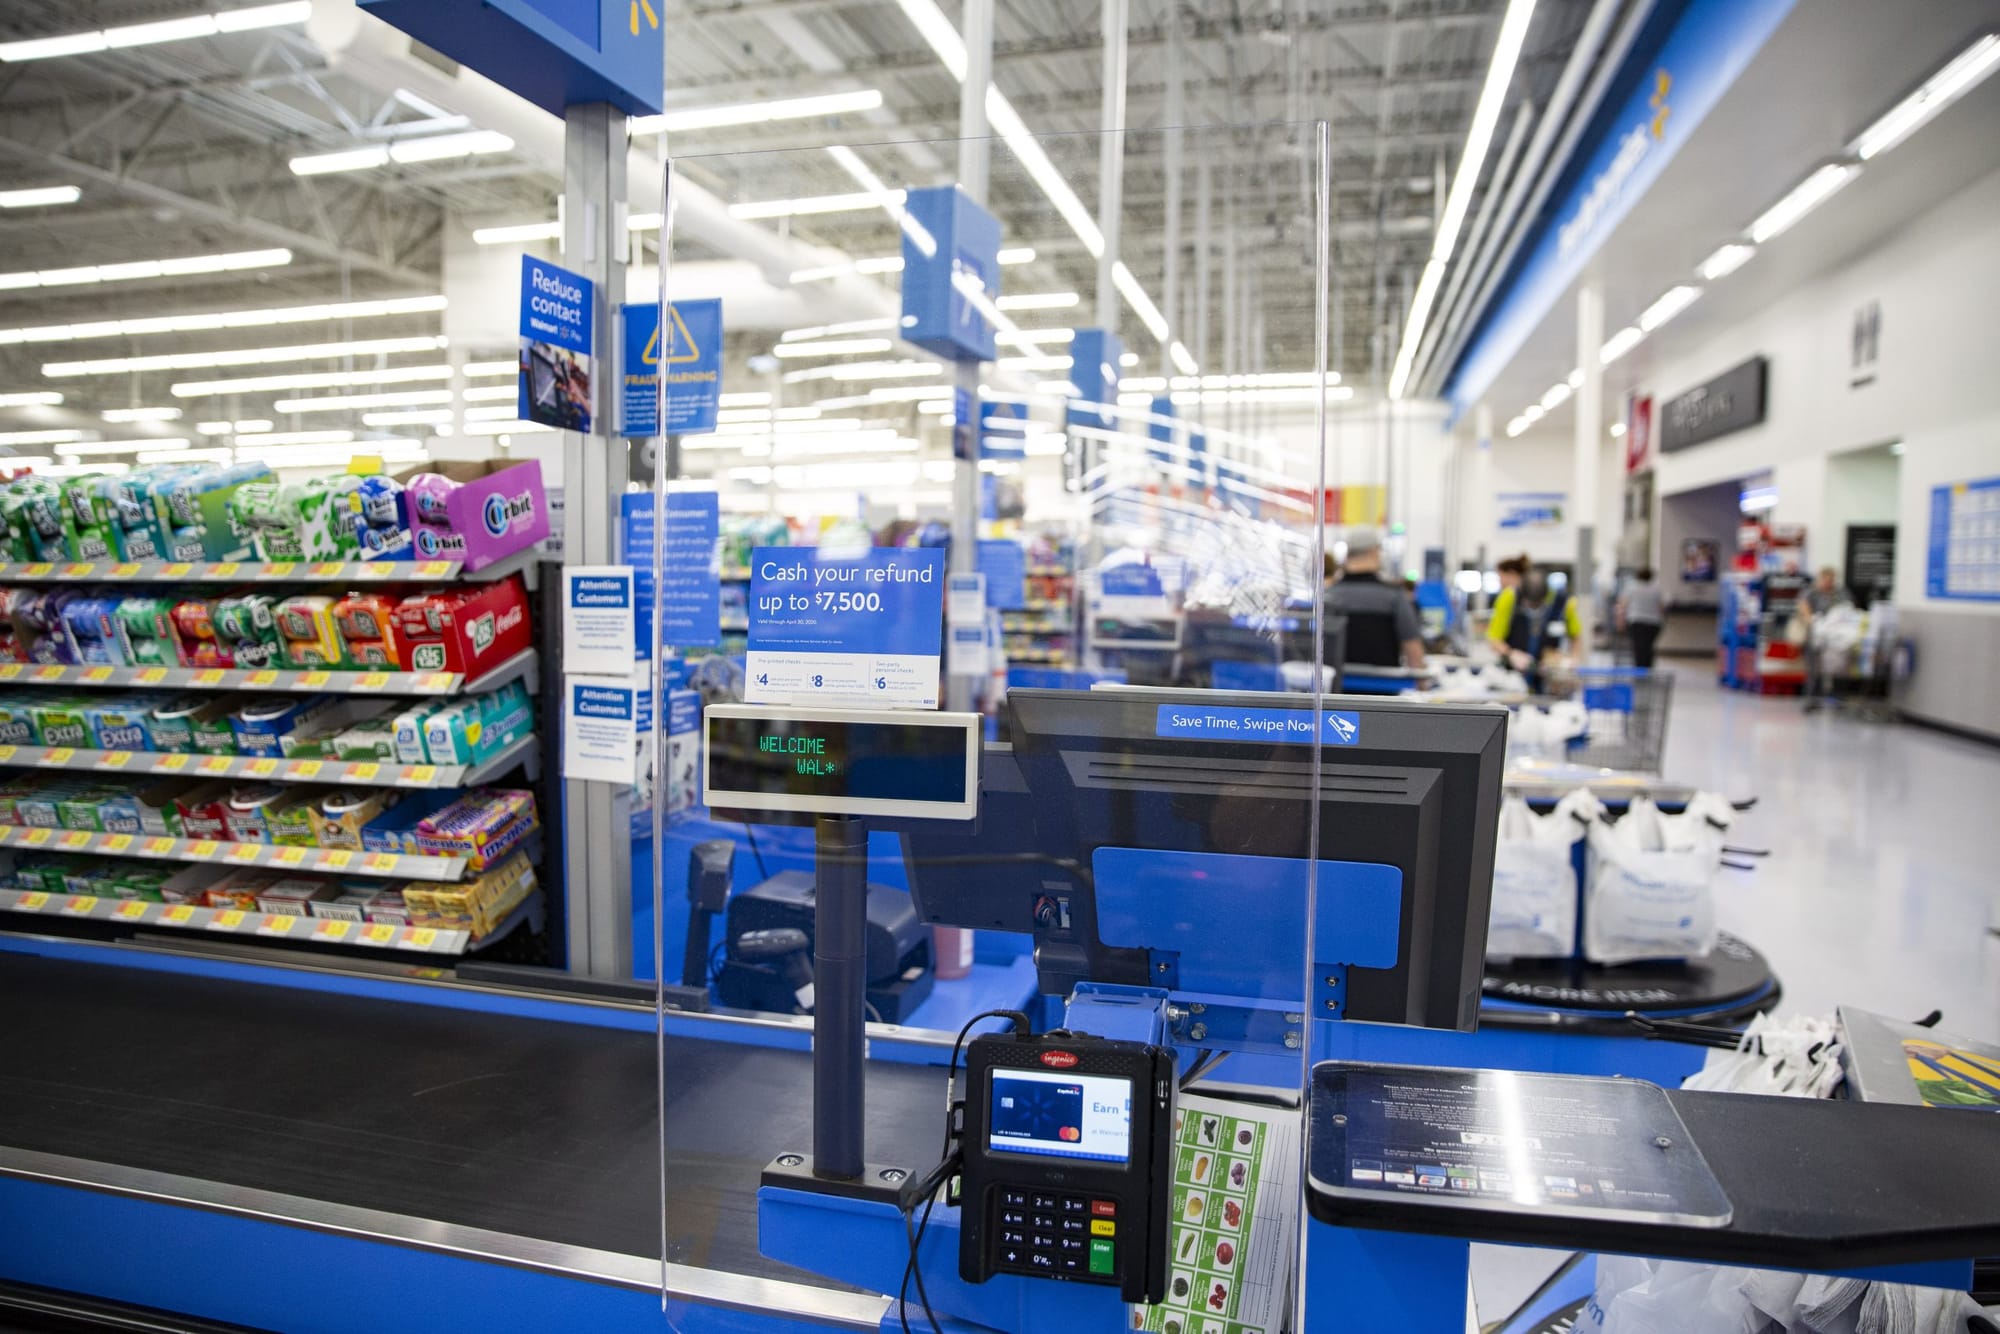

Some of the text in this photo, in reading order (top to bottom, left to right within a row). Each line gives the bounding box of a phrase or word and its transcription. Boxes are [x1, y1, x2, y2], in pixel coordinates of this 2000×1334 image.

[532, 266, 582, 304] Reduce
[531, 296, 582, 326] contact
[624, 374, 656, 385] FRAU
[483, 490, 533, 537] Orbit
[417, 529, 466, 558] Orbit
[760, 562, 933, 586] Cash your refund
[579, 579, 622, 590] Attention
[576, 592, 624, 604] Customers
[760, 592, 884, 614] up to $7,500.
[756, 673, 768, 686] $4
[812, 675, 823, 688] $8
[875, 676, 886, 690] $6
[582, 689, 624, 702] Attention
[579, 701, 626, 716] Customers
[1172, 714, 1202, 728] Save
[1205, 716, 1240, 730] Time,
[1244, 718, 1284, 733] Swipe
[44, 724, 84, 745] Extra
[100, 726, 143, 748] Extra
[760, 736, 826, 754] WELCOME
[420, 838, 472, 850] mentos
[484, 816, 534, 860] mentos
[1504, 981, 1598, 1002] MORE
[1044, 1052, 1074, 1066] ingenico
[1092, 1102, 1119, 1114] Earn
[1036, 1198, 1042, 1206] 2
[1065, 1201, 1071, 1210] 3
[1004, 1214, 1011, 1222] 4
[1035, 1217, 1041, 1226] 5
[1064, 1220, 1070, 1230] 6
[1004, 1232, 1011, 1241] 7
[1034, 1236, 1040, 1245] 8
[1062, 1239, 1069, 1248] 9
[1094, 1243, 1110, 1252] Enter
